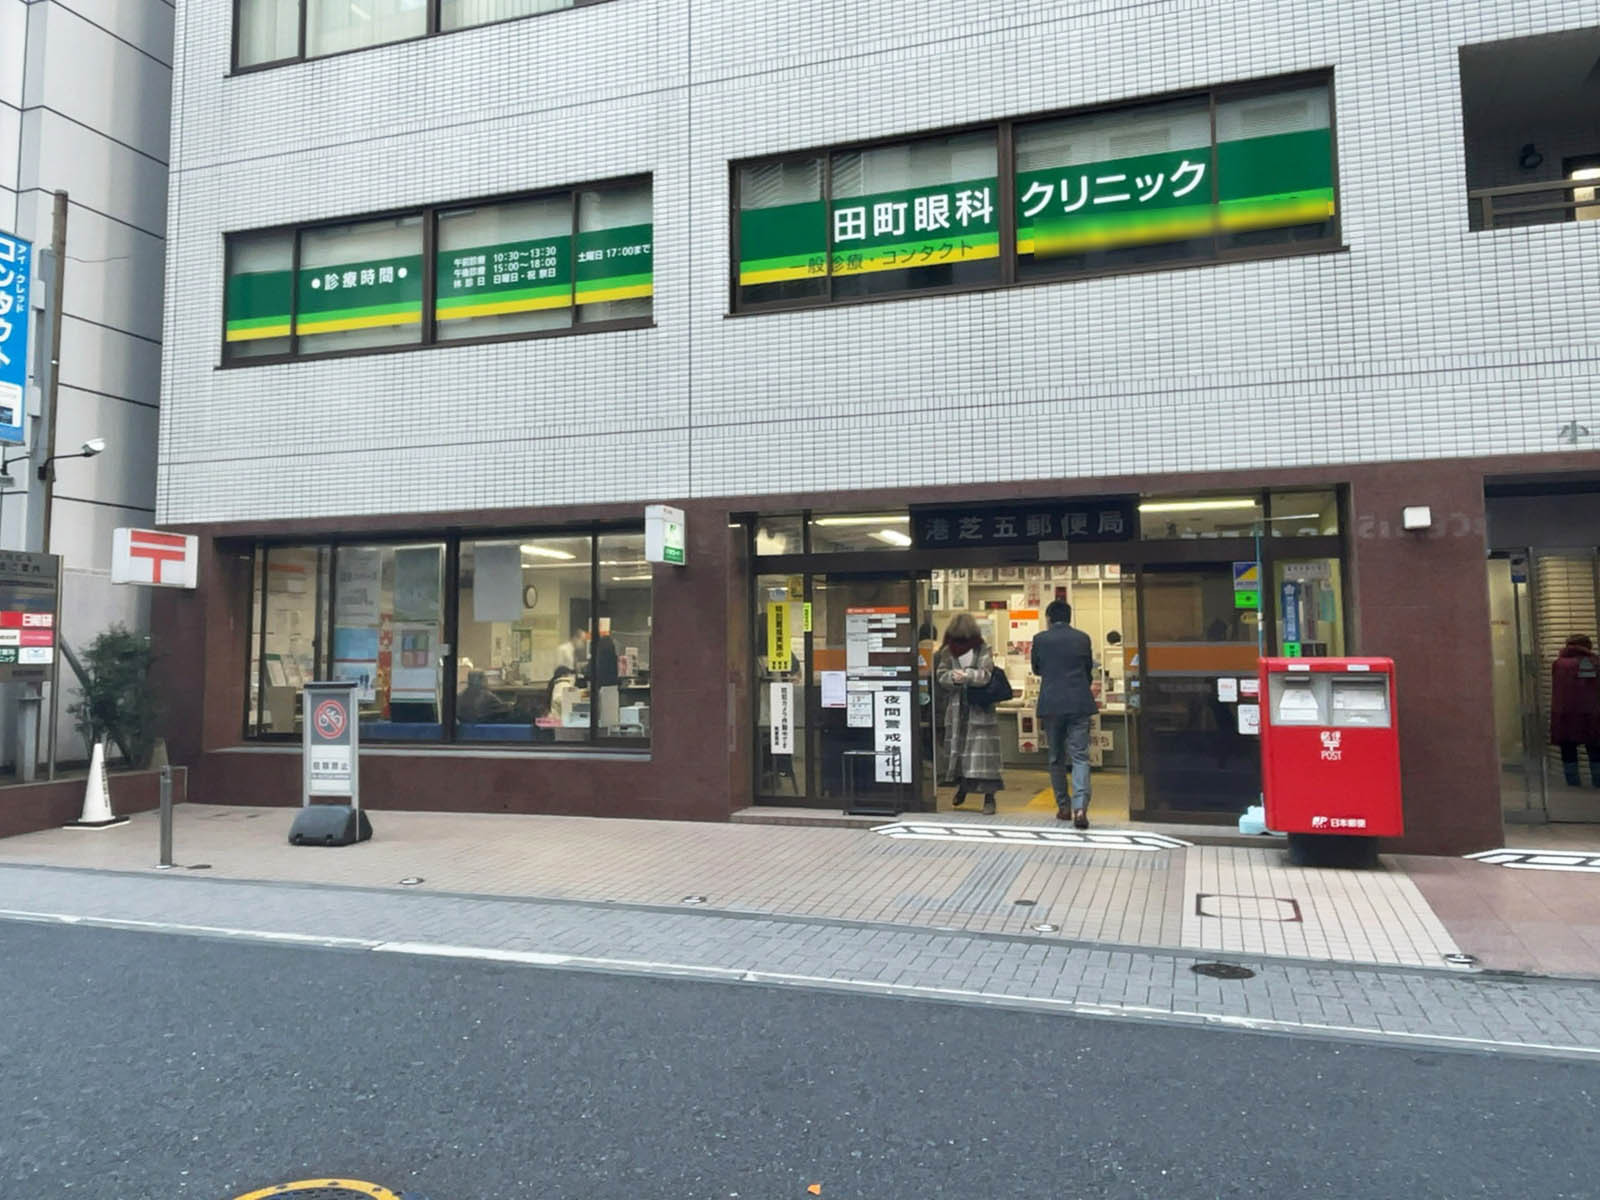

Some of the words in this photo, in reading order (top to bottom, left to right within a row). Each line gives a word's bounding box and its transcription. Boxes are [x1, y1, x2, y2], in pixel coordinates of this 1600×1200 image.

[833, 187, 994, 243] 田町眼科
[1022, 160, 1206, 218] クリニック
[789, 239, 974, 275] 一般診療・コンタクト
[324, 265, 394, 291] 診療時間
[925, 510, 1124, 541] 港芝五郵便局
[1320, 750, 1342, 761] POST
